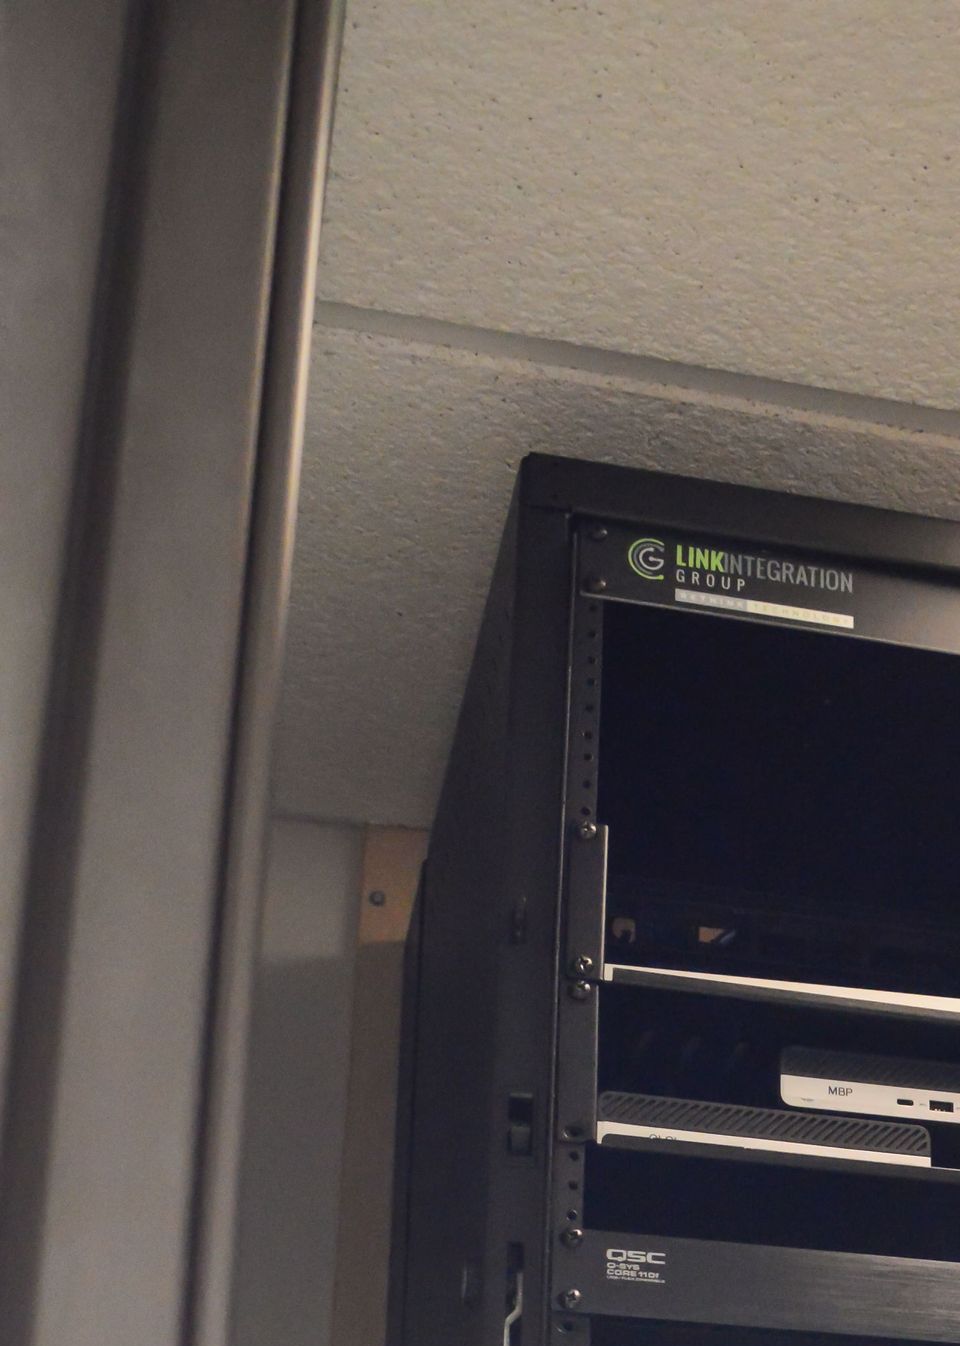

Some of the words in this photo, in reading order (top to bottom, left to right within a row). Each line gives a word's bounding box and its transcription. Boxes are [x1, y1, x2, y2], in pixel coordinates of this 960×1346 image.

[676, 569, 746, 592] GROUP
[828, 1086, 853, 1096] MBP
[606, 1248, 666, 1265] QSC
